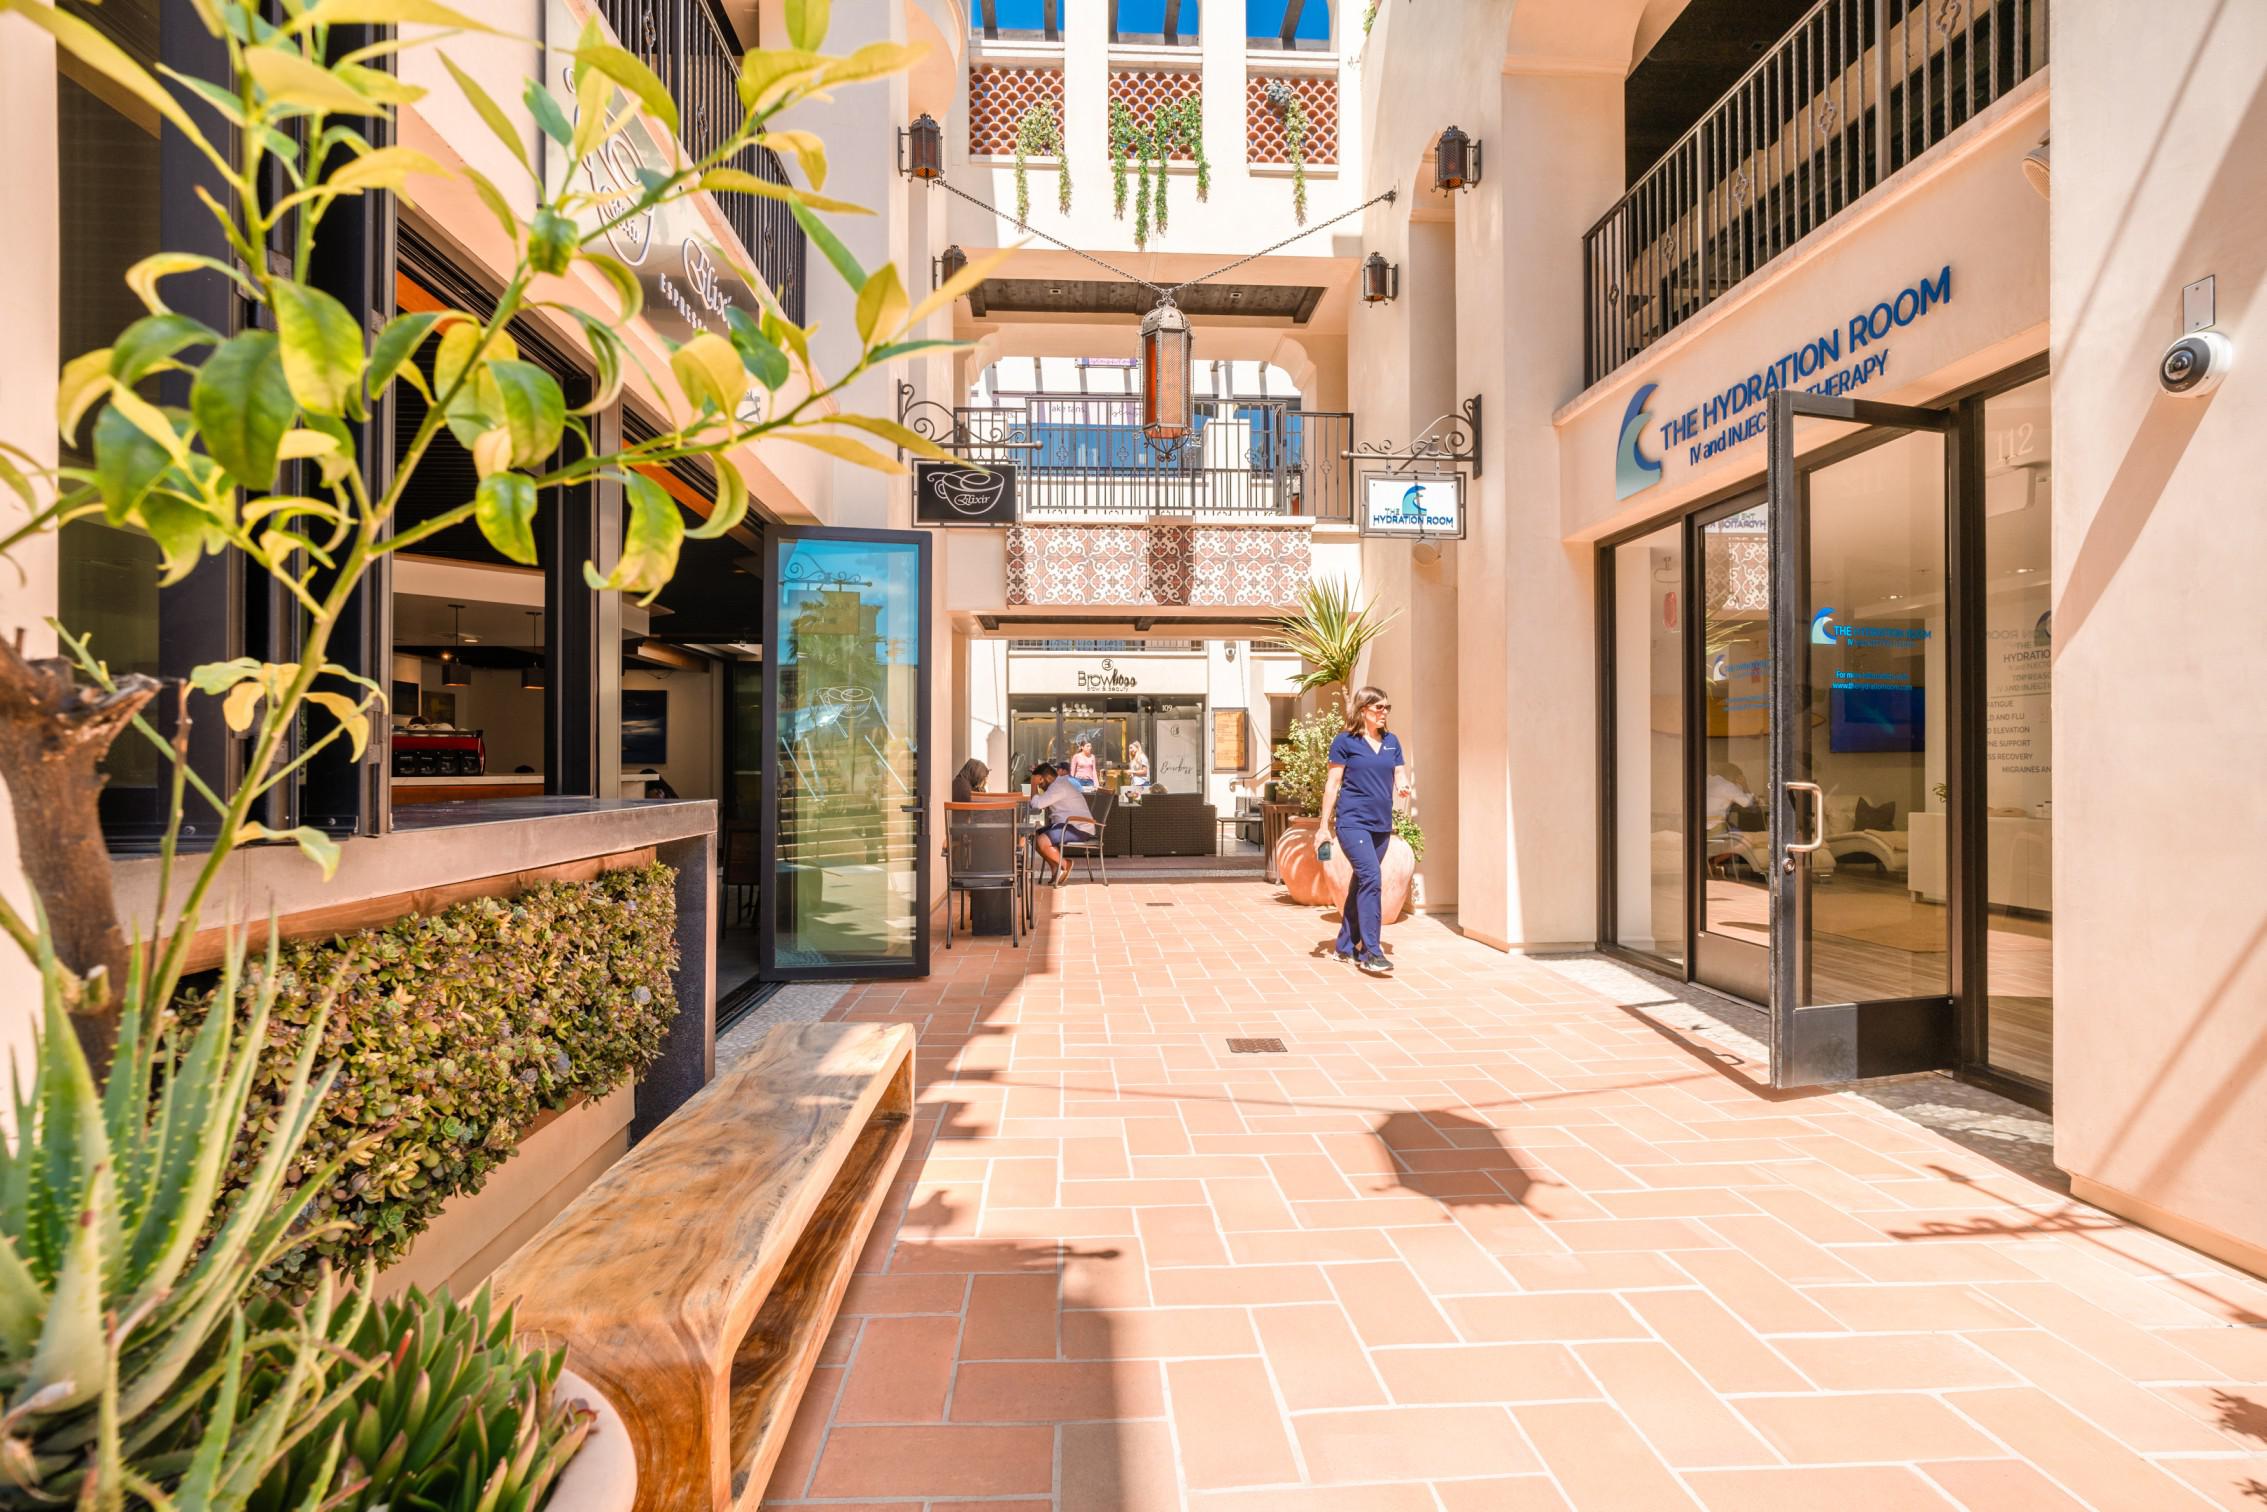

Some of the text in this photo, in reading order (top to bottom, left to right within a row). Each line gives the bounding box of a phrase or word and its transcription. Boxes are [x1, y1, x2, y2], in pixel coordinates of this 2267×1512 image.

[1660, 265, 1951, 451] THE HYDRATION ROOM
[1689, 443, 1702, 466] IV
[1703, 430, 1726, 460] and
[1728, 411, 1767, 447] INJEC
[1998, 422, 2034, 464] 112
[954, 493, 991, 506] Elixir
[1373, 515, 1454, 526] HYDRATION ROOM
[1834, 625, 1852, 636] THE
[2003, 649, 2051, 663] HYDRATIO
[1162, 704, 1173, 712] 109
